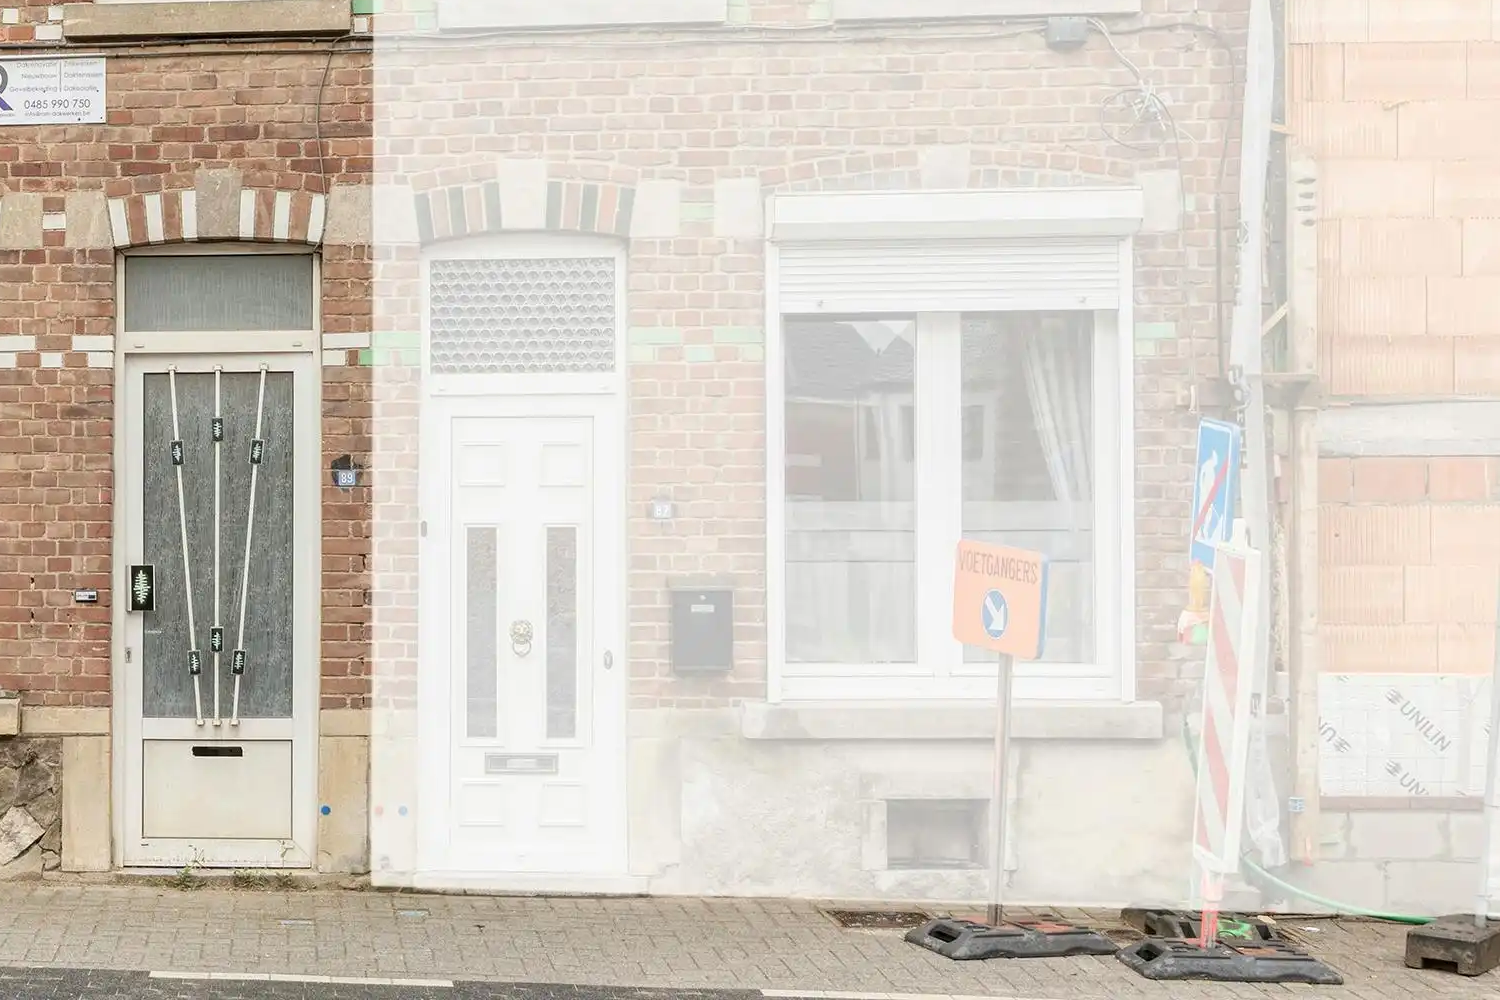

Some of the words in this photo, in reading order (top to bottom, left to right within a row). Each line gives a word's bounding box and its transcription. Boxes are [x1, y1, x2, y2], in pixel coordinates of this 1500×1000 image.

[24, 99, 48, 109] 0485
[51, 99, 69, 109] 990
[72, 98, 91, 108] 750
[341, 472, 353, 483] 89
[655, 505, 669, 517] 87
[958, 549, 1039, 585] VOETGANGERS
[1399, 700, 1451, 752] UNILIN
